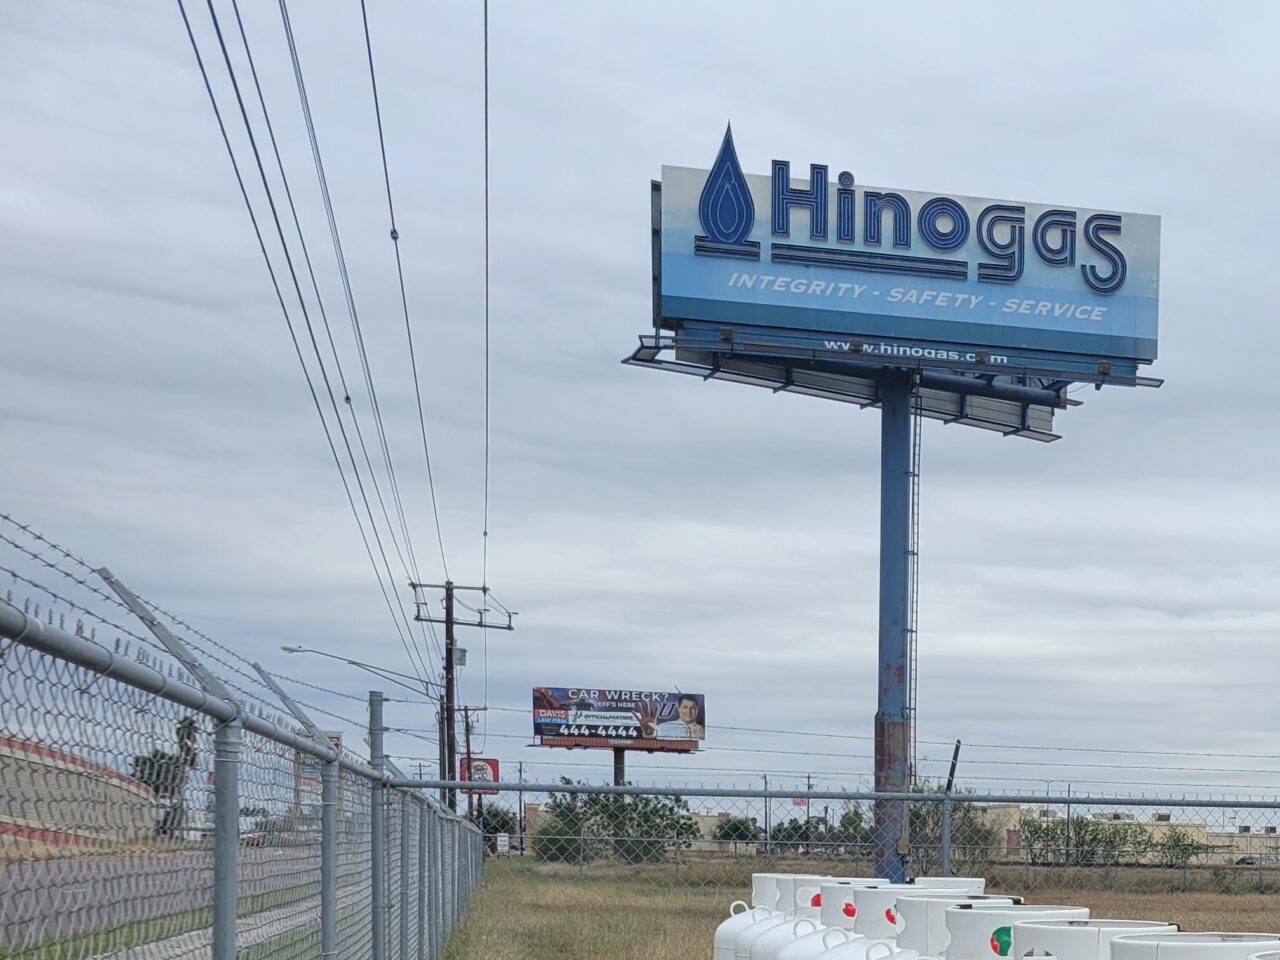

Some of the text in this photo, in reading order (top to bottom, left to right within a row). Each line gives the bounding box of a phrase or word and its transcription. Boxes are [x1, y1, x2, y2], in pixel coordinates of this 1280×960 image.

[771, 159, 1128, 295] Hinogas
[727, 272, 866, 299] INTEGRITY
[886, 287, 984, 308] SAFETY
[1001, 298, 1107, 322] SERVICE
[568, 690, 668, 701] CAR WRECK?
[539, 709, 566, 717] DAVIS
[559, 725, 637, 736] 444-4444
